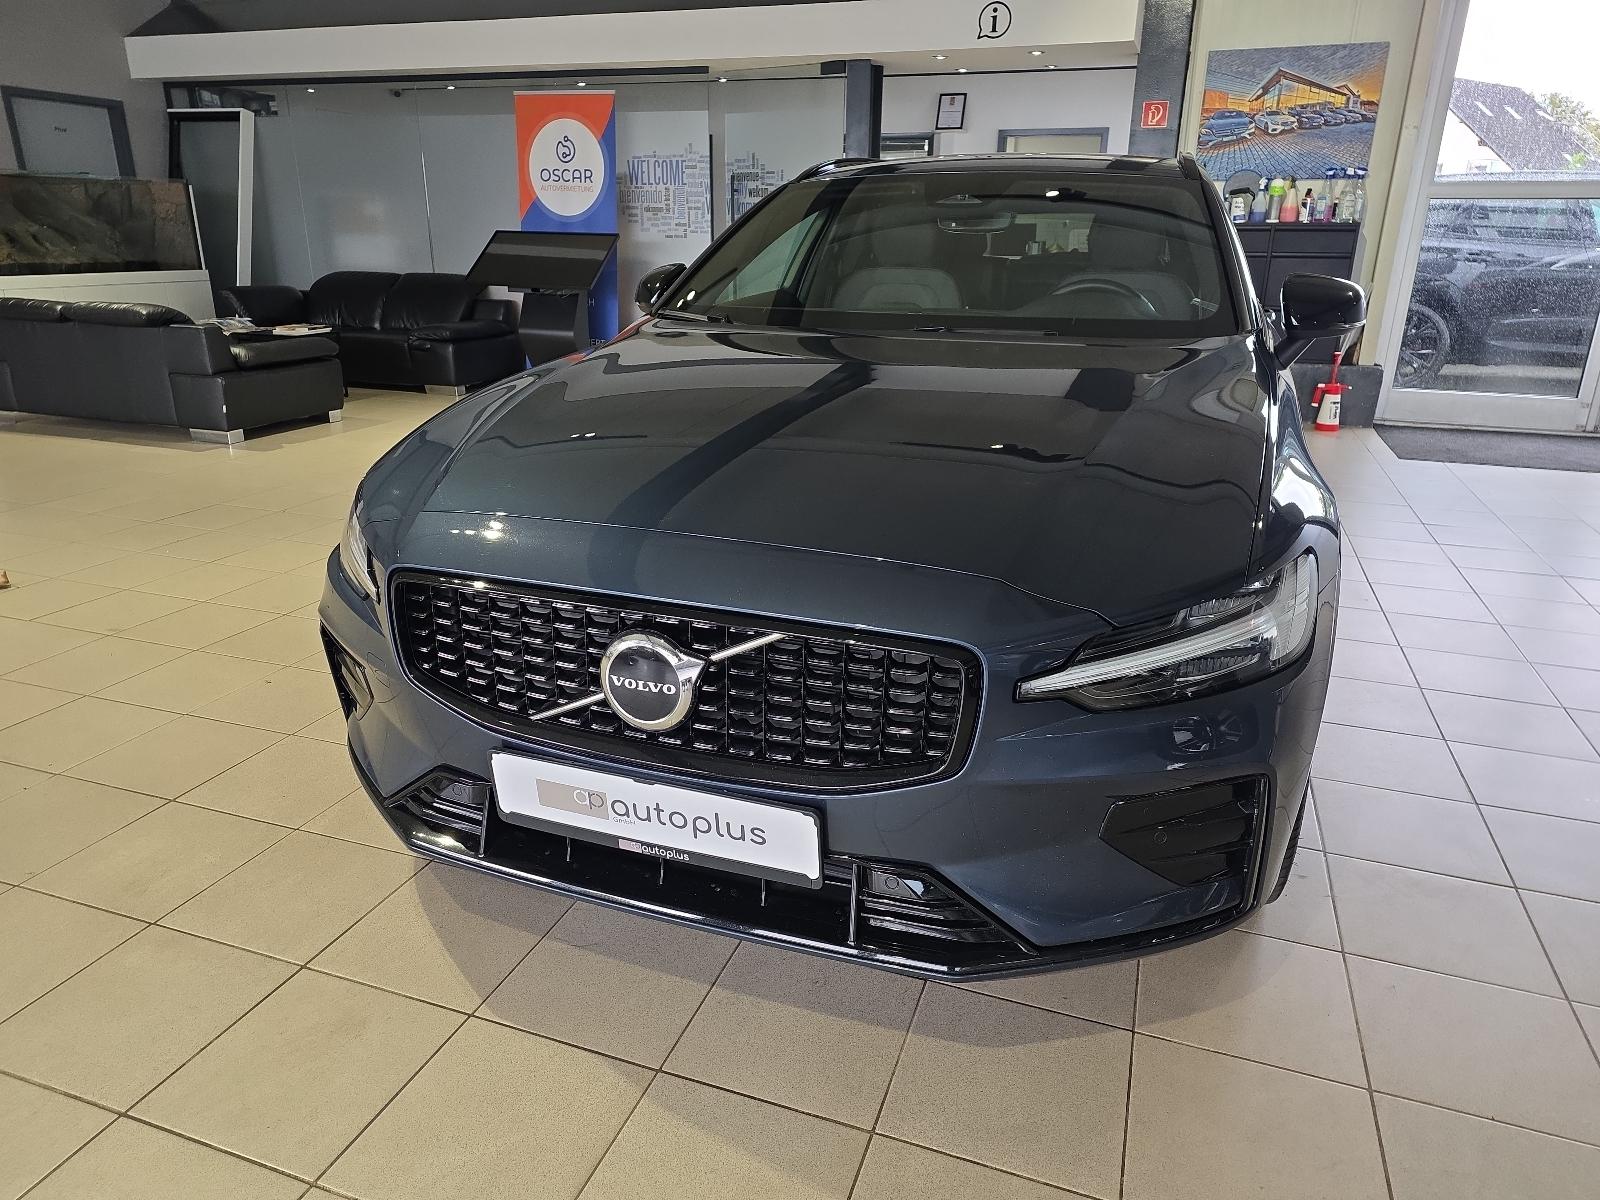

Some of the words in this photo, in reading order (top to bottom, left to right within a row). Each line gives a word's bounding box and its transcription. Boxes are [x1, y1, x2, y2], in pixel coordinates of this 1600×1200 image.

[540, 168, 593, 183] OSCAR
[627, 160, 687, 186] WELCOME
[541, 184, 594, 193] AUTOVERMIETUNG
[619, 185, 662, 204] bienvenido
[610, 675, 677, 695] VOLVO
[611, 800, 767, 845] autoplus
[642, 845, 690, 861] autoplus
